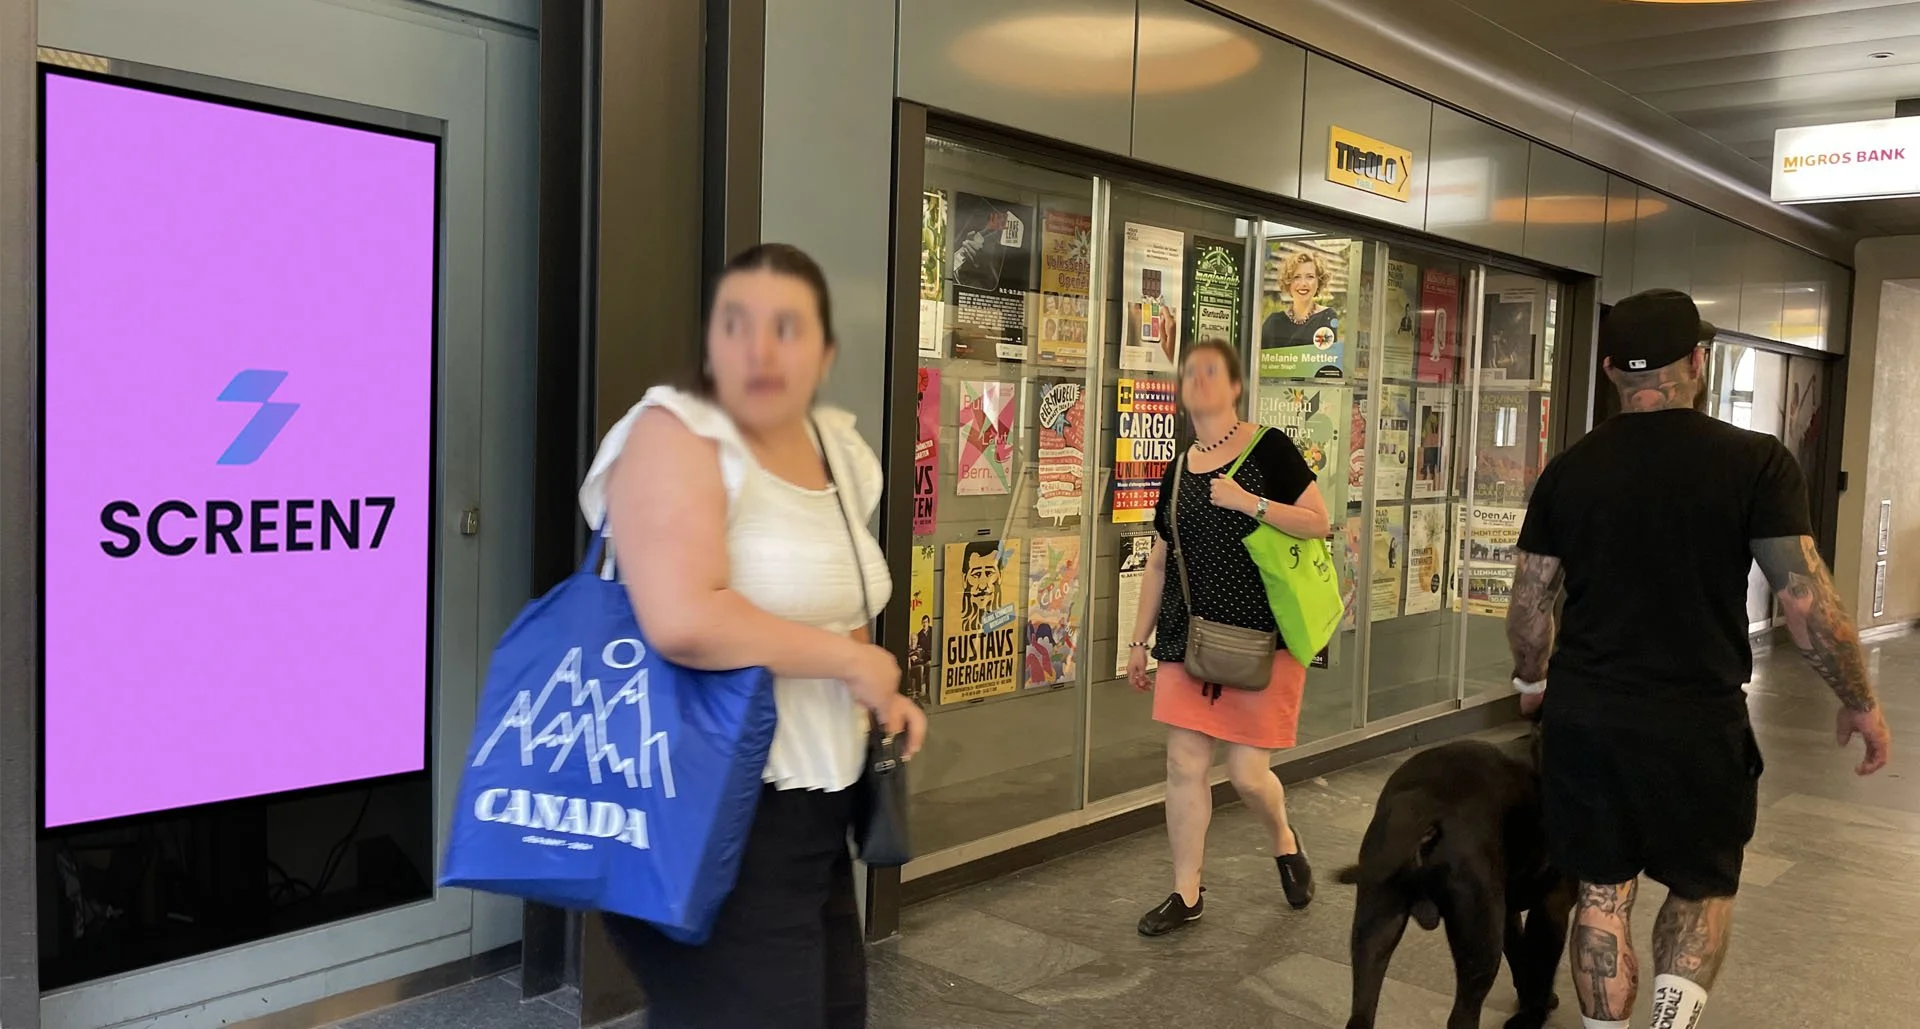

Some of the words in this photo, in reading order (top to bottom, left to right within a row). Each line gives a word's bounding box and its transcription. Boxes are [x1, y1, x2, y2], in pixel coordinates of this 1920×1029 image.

[1784, 152, 1851, 172] MIGROS
[1857, 147, 1906, 163] BANK
[1261, 353, 1299, 363] Melanie
[1301, 353, 1339, 363] Mettler
[1260, 397, 1313, 412] Elfenau
[1119, 413, 1175, 438] CARGO
[1260, 411, 1304, 426] Kultur
[1281, 427, 1314, 439] mer
[1133, 440, 1173, 460] CULTS
[1117, 462, 1165, 478] UNLIMITE
[1474, 510, 1500, 520] Open
[1502, 512, 1517, 520] Air
[100, 496, 396, 559] SCREEN7
[1041, 582, 1069, 606] Ciao
[948, 629, 1013, 665] GUSTAVS
[946, 658, 1013, 688] BIERGARTEN
[474, 788, 650, 850] CANADA
[1659, 987, 1683, 1029] ONDIALE
